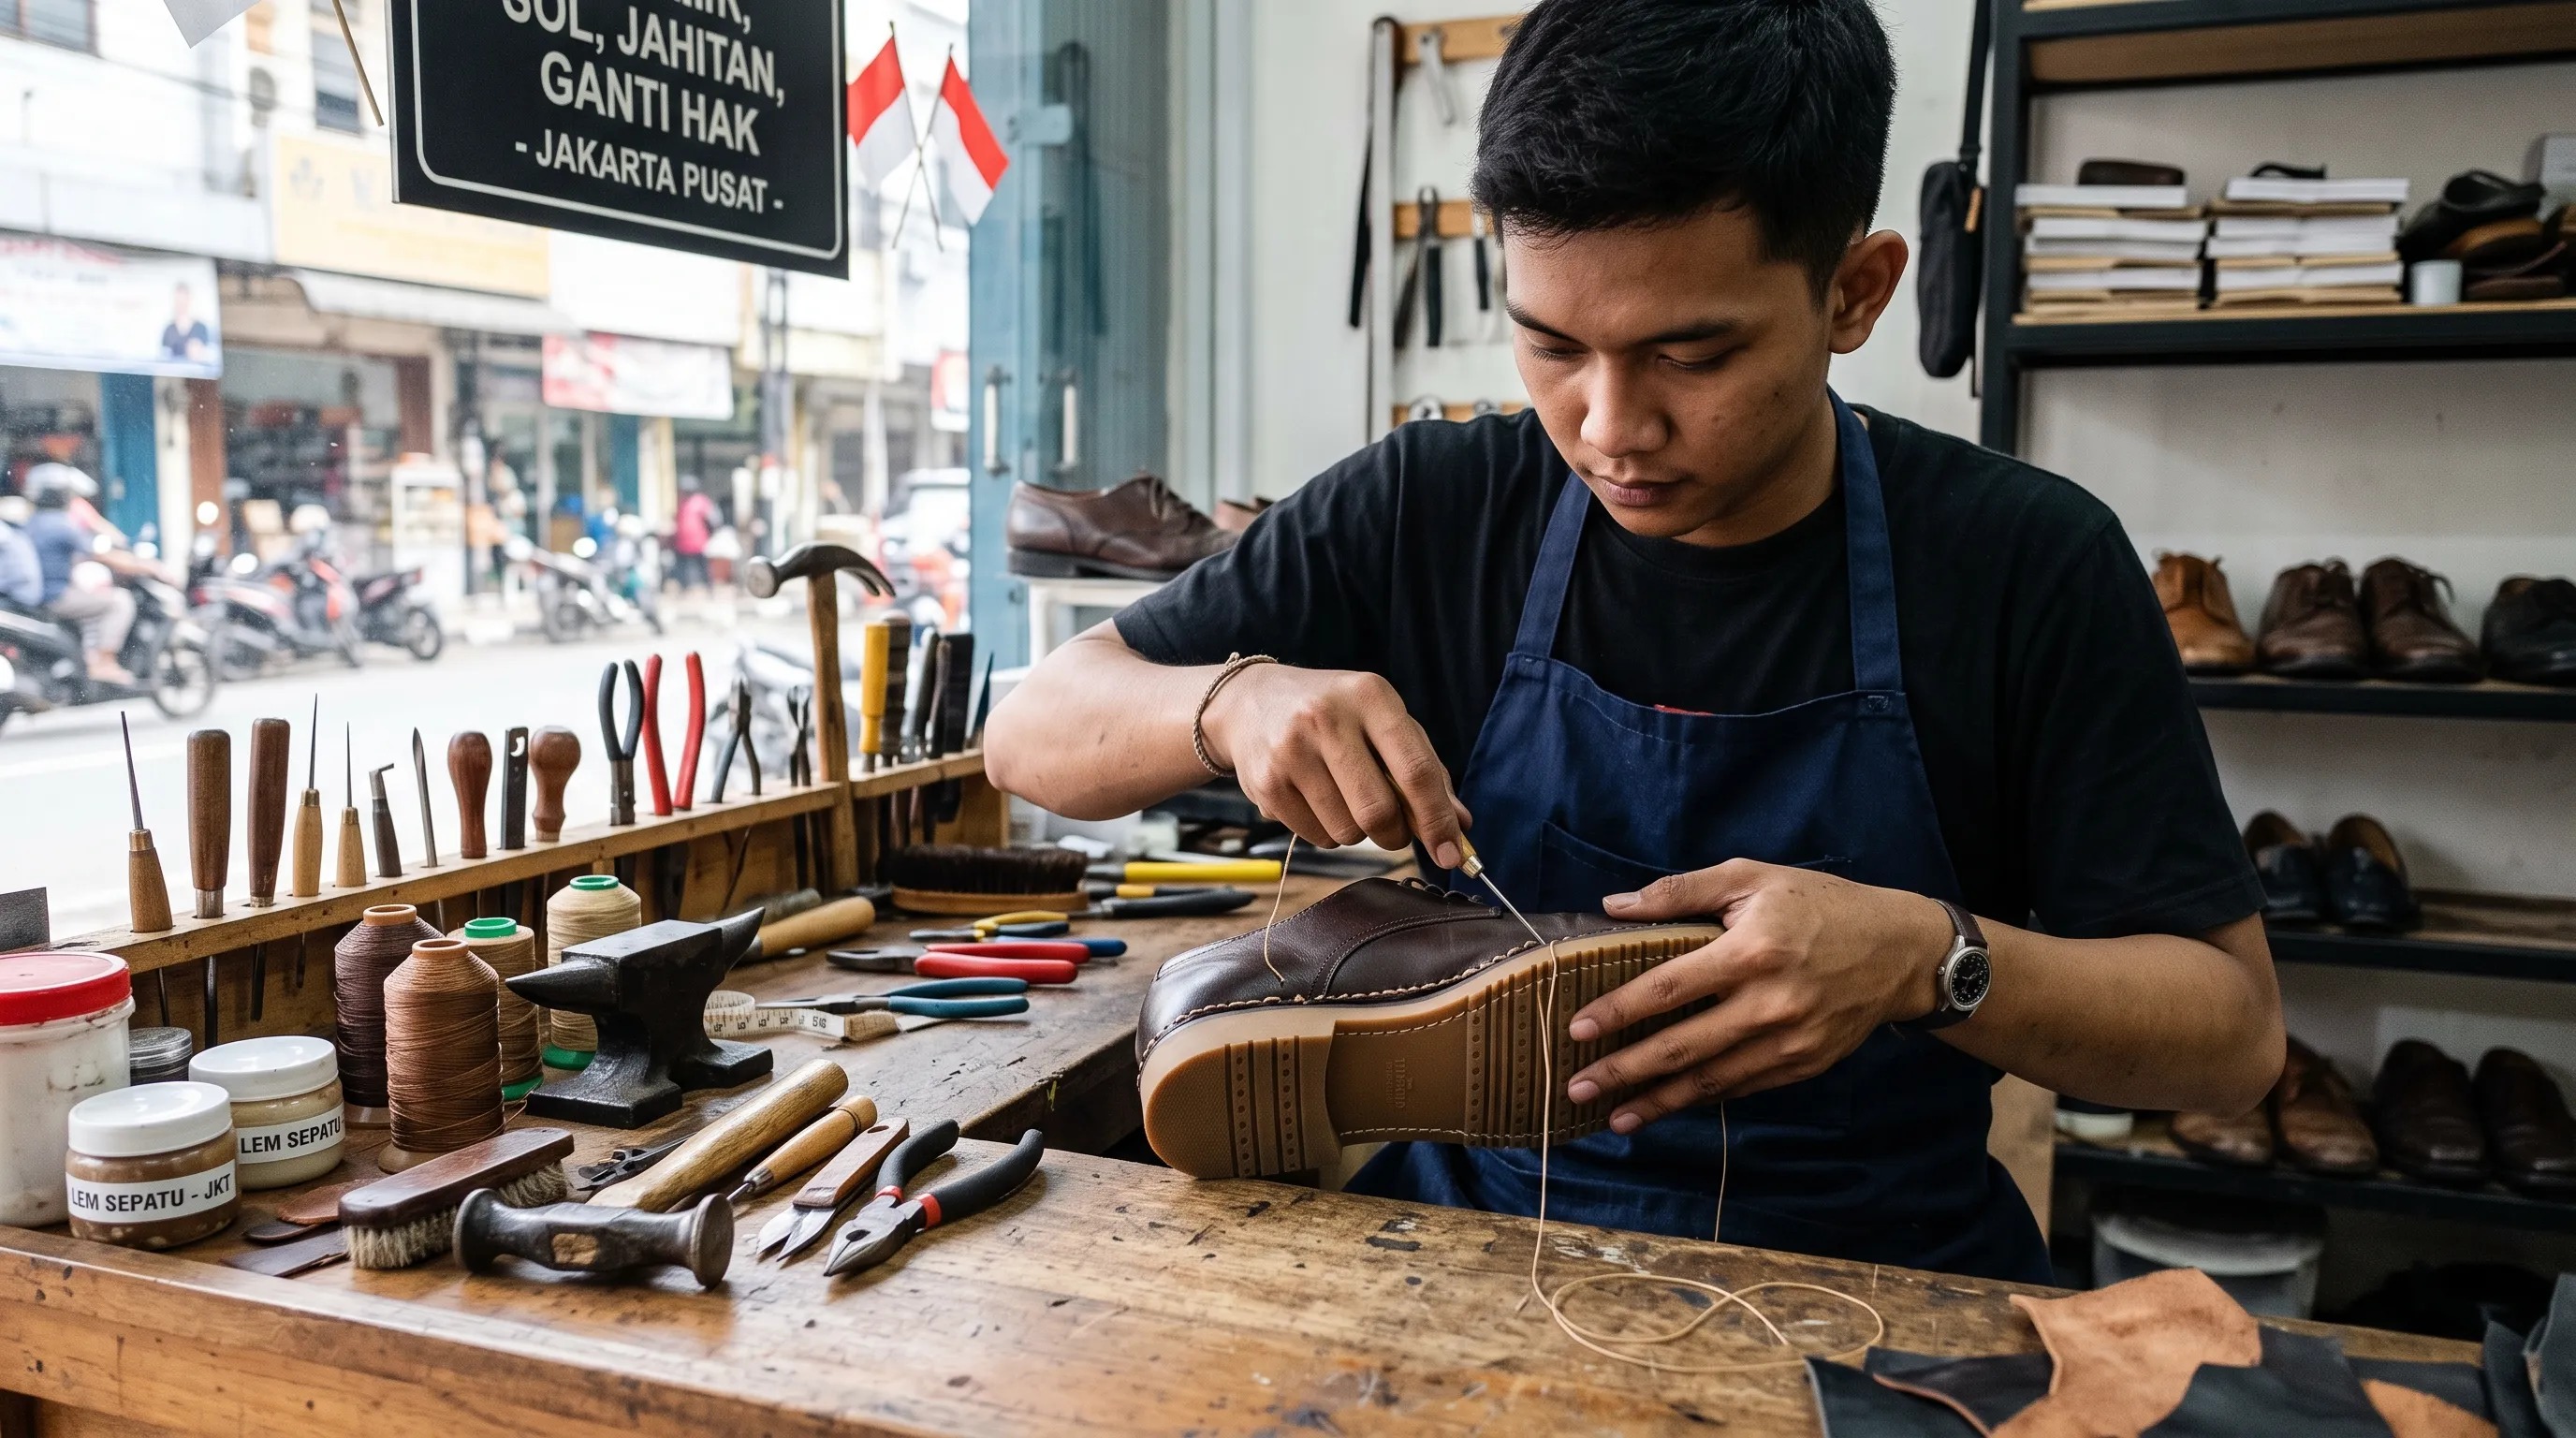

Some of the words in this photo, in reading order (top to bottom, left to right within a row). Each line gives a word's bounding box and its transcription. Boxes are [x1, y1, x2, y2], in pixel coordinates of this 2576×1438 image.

[617, 6, 784, 108] JAHITAN,
[540, 51, 669, 132] GANTI
[681, 89, 760, 156] HAK
[535, 128, 677, 195] JAKARTA
[683, 162, 768, 213] PUSAT
[240, 1135, 282, 1154] LEM
[287, 1116, 341, 1149] SEPATU
[71, 1187, 99, 1211] LEM
[105, 1188, 184, 1212] SEPATU
[204, 1173, 231, 1199] JKT
